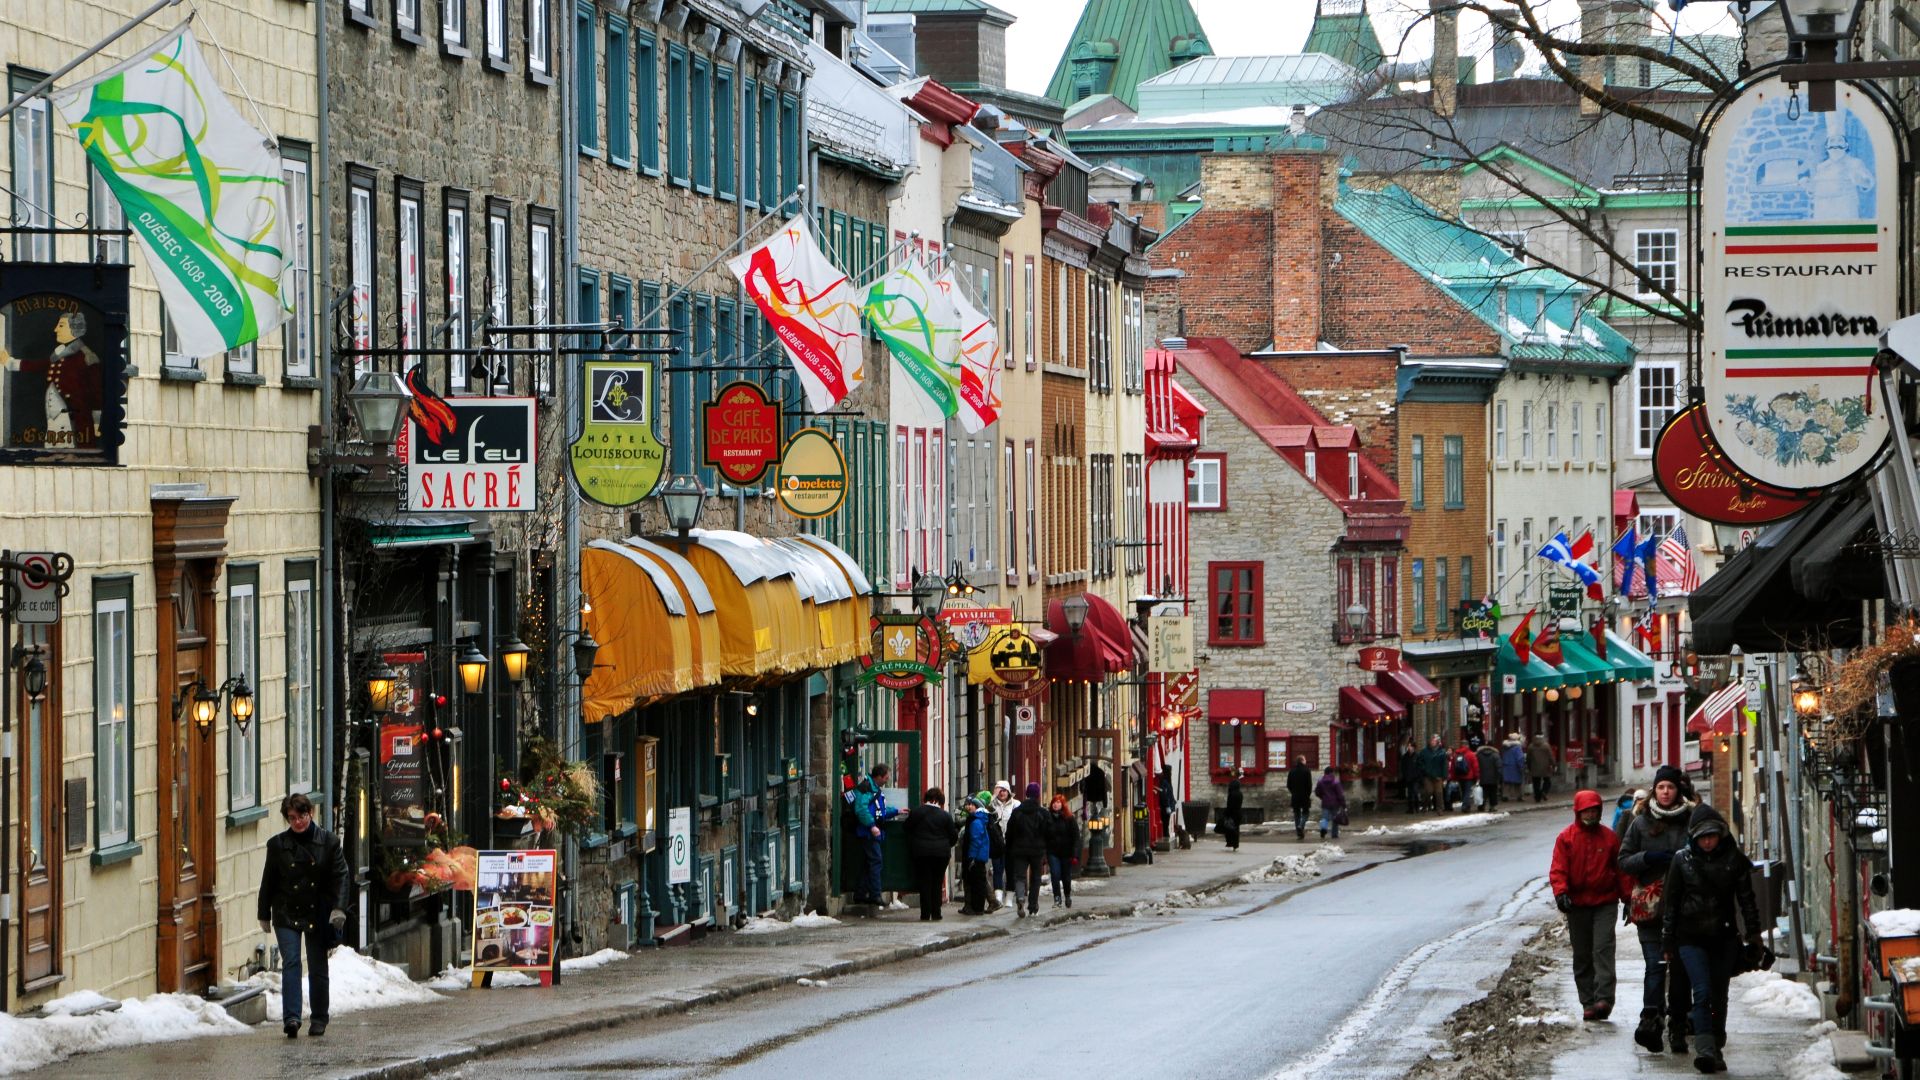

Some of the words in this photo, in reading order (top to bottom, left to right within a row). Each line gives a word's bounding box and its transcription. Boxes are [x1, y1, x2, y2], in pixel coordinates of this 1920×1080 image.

[139, 212, 182, 256] QUÉBEC
[179, 255, 205, 282] 1608
[204, 285, 233, 316] 2008
[1725, 264, 1878, 277] RESTAURANT
[15, 296, 80, 316] Maison
[778, 325, 805, 351] QUÉBEC
[803, 348, 819, 366] 1608
[819, 366, 836, 384] 2008
[897, 351, 922, 375] QUÉBEC
[588, 433, 646, 443] HÔTEL
[711, 429, 730, 445] DE
[733, 428, 773, 445] PARIS
[574, 446, 660, 460] LOUISBOURG
[723, 449, 762, 457] RESTAURANT
[421, 465, 521, 508] SACRÉ
[795, 492, 829, 500] restaurant
[29, 602, 37, 611] CE
[952, 611, 995, 619] CAVALIER
[874, 662, 925, 672] CRÉMAZIE
